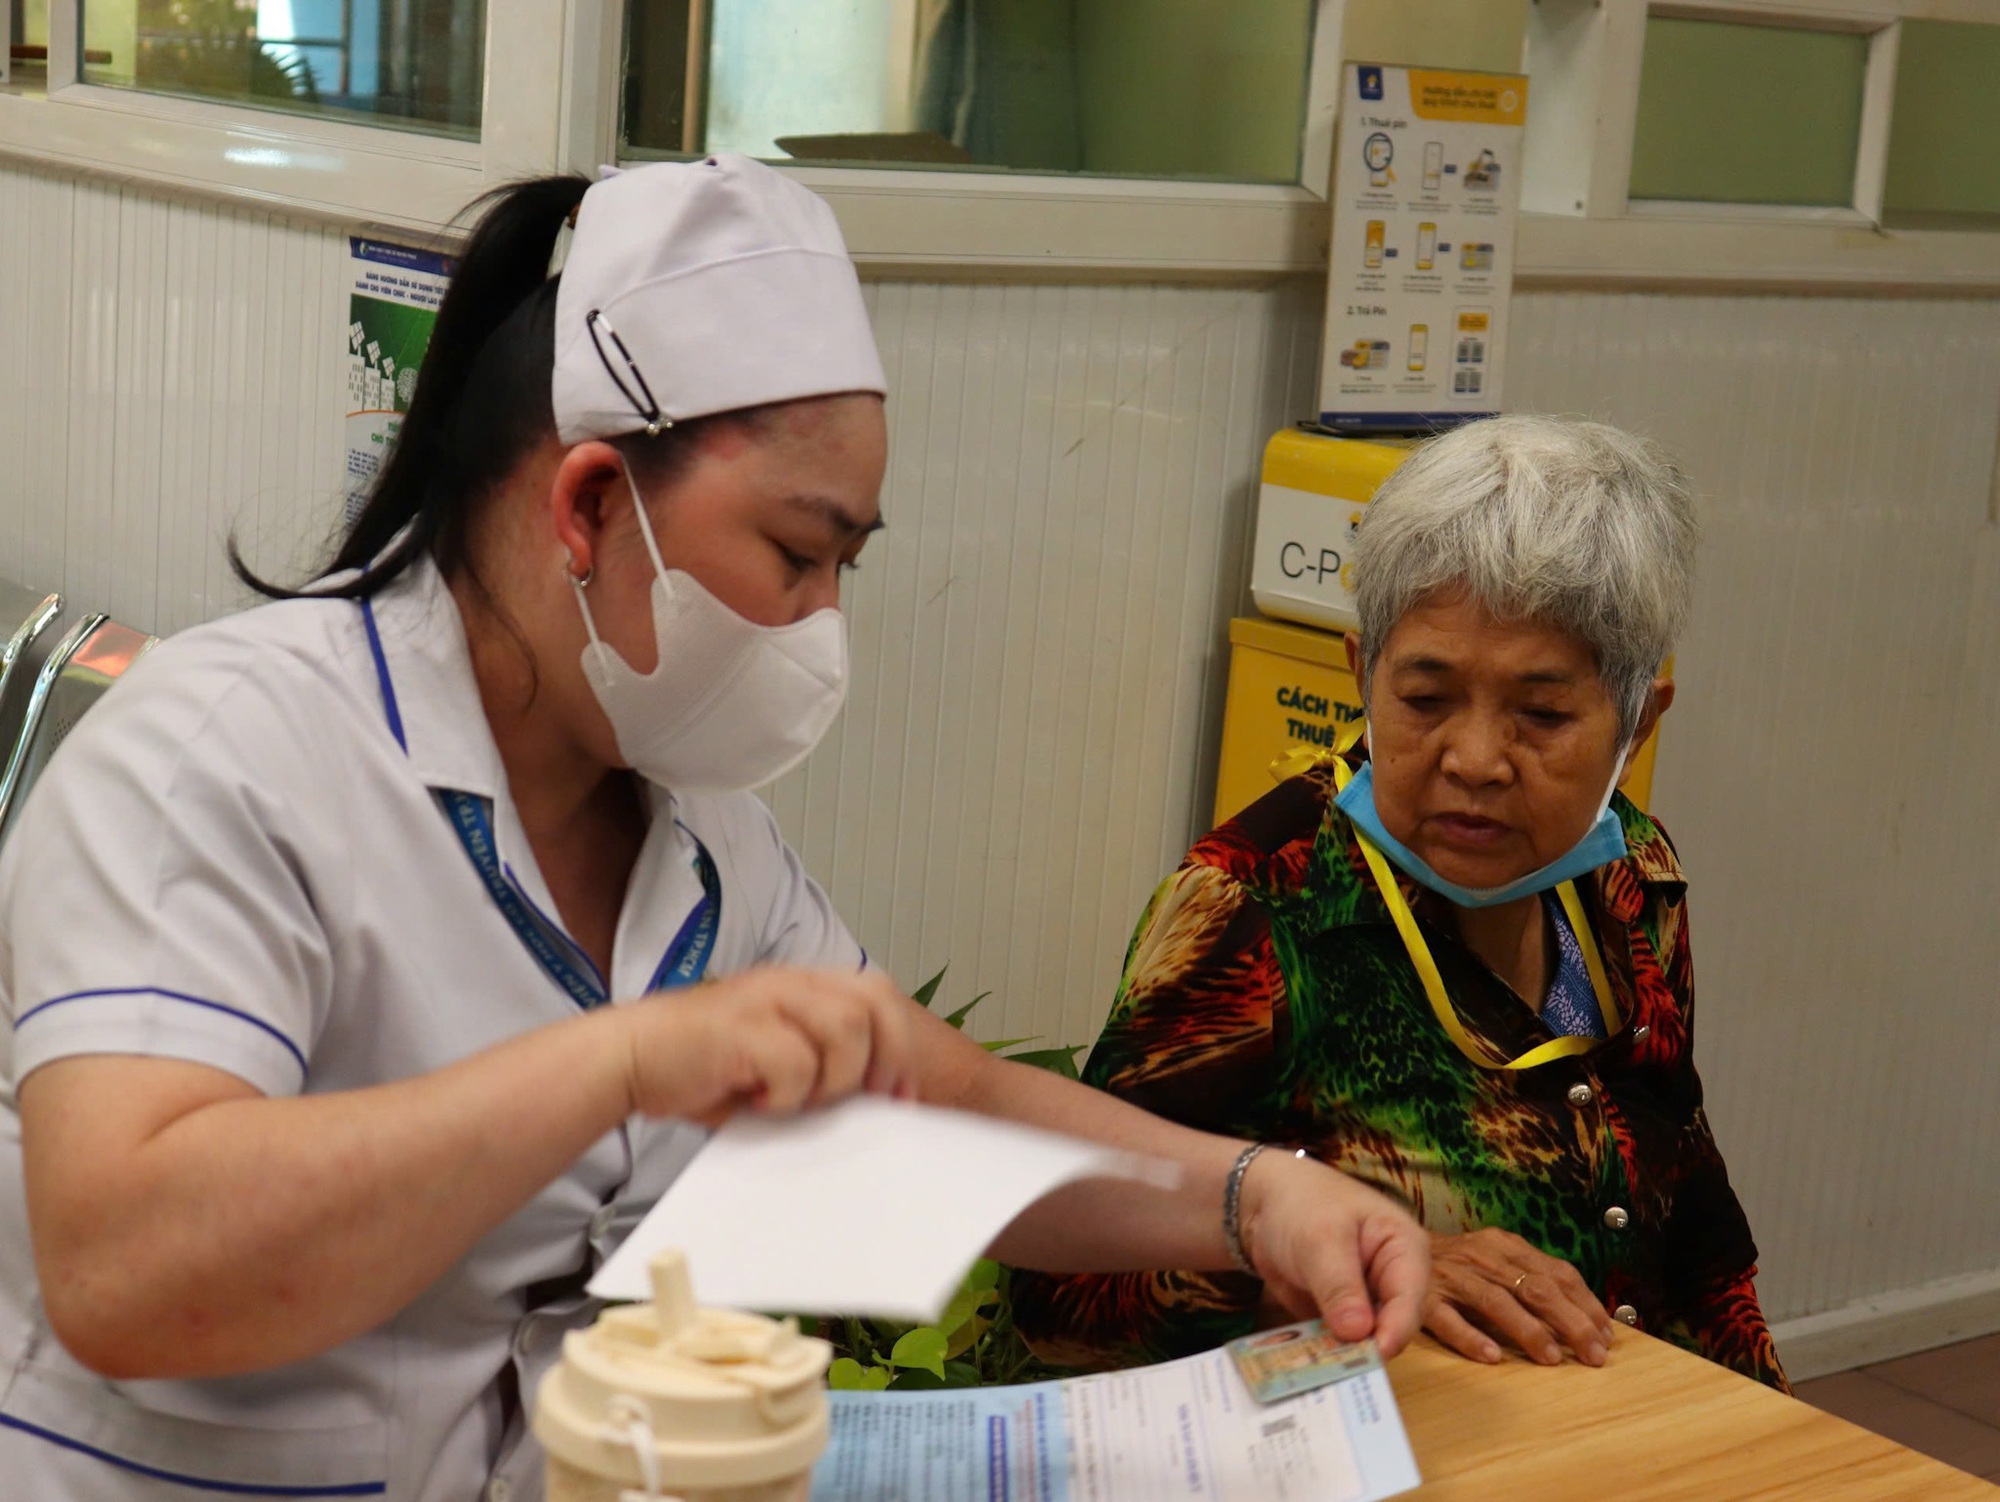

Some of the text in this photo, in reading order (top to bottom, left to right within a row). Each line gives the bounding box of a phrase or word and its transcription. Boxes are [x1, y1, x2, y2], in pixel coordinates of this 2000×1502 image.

[1277, 685, 1361, 723] CÁCH TH
[1286, 717, 1336, 748] THUÊ
